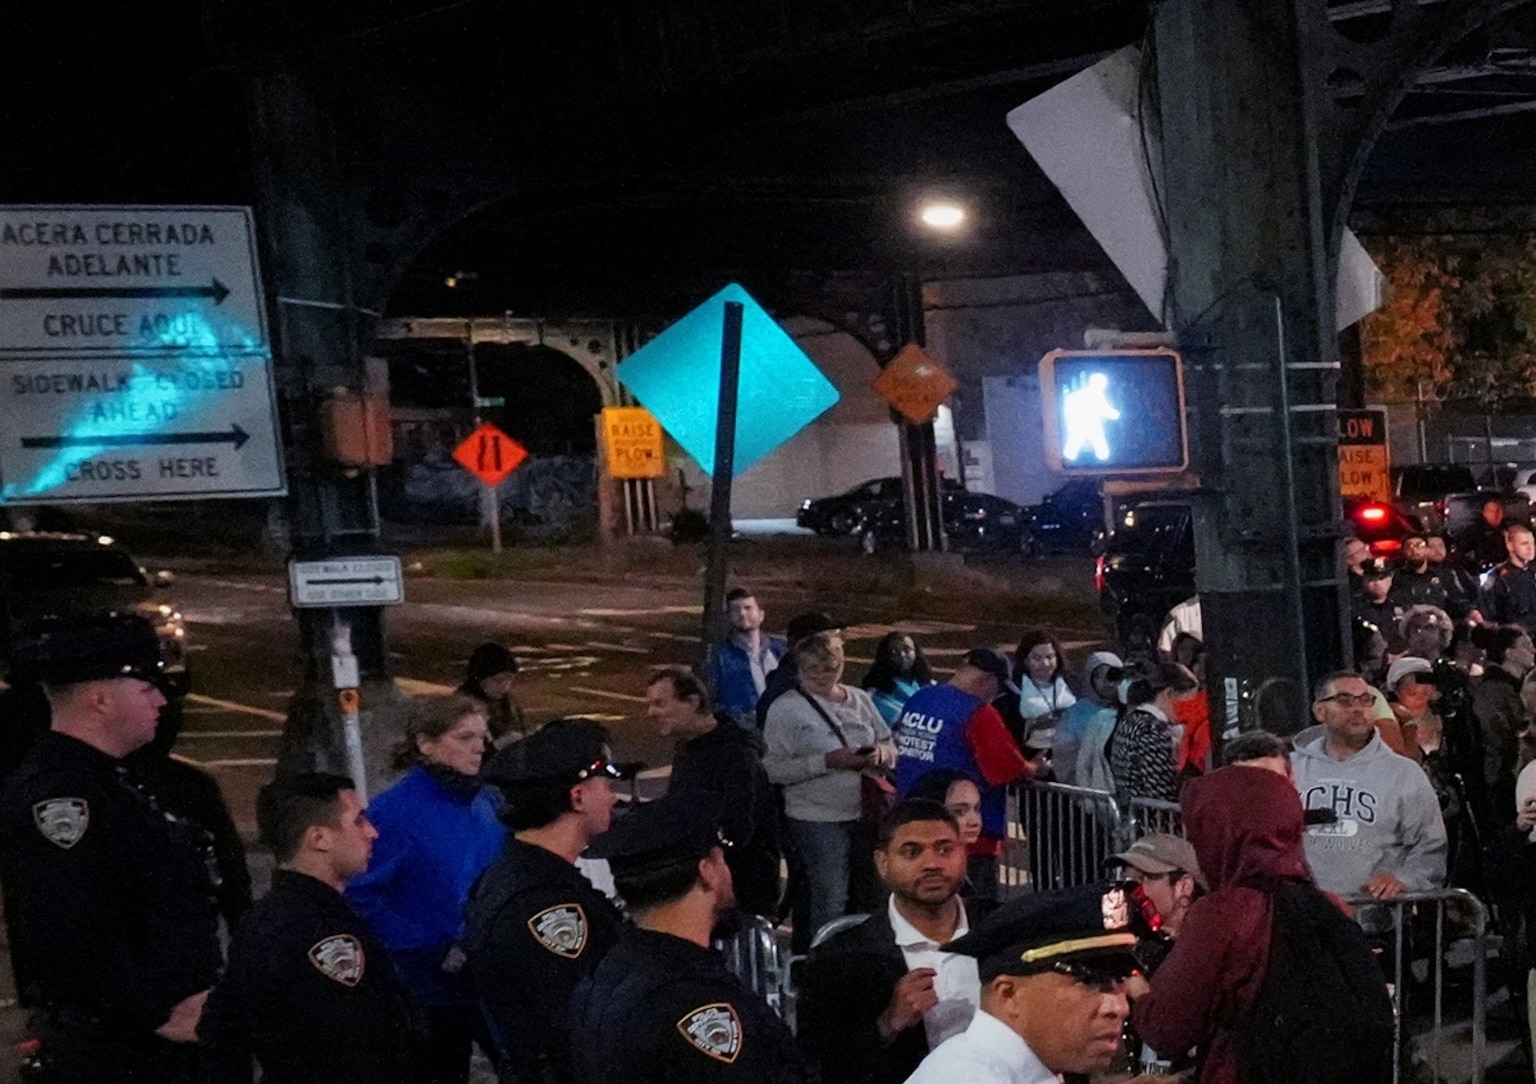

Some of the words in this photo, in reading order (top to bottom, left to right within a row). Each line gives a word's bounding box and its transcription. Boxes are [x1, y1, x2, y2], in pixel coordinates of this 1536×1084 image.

[3, 225, 88, 246] ACERA
[99, 224, 215, 246] CERRADA
[47, 254, 181, 277] ADELANTE
[43, 314, 129, 337] CRUCE
[12, 373, 127, 395] SIDEWALK
[156, 370, 244, 391] CLOSED
[92, 402, 178, 422] AHEAD
[1340, 449, 1374, 464] AISE
[66, 460, 141, 483] CROSS
[158, 458, 219, 479] HERE
[1340, 471, 1373, 486] LOW
[902, 711, 944, 734] ACLU
[1299, 784, 1377, 825] CHS
